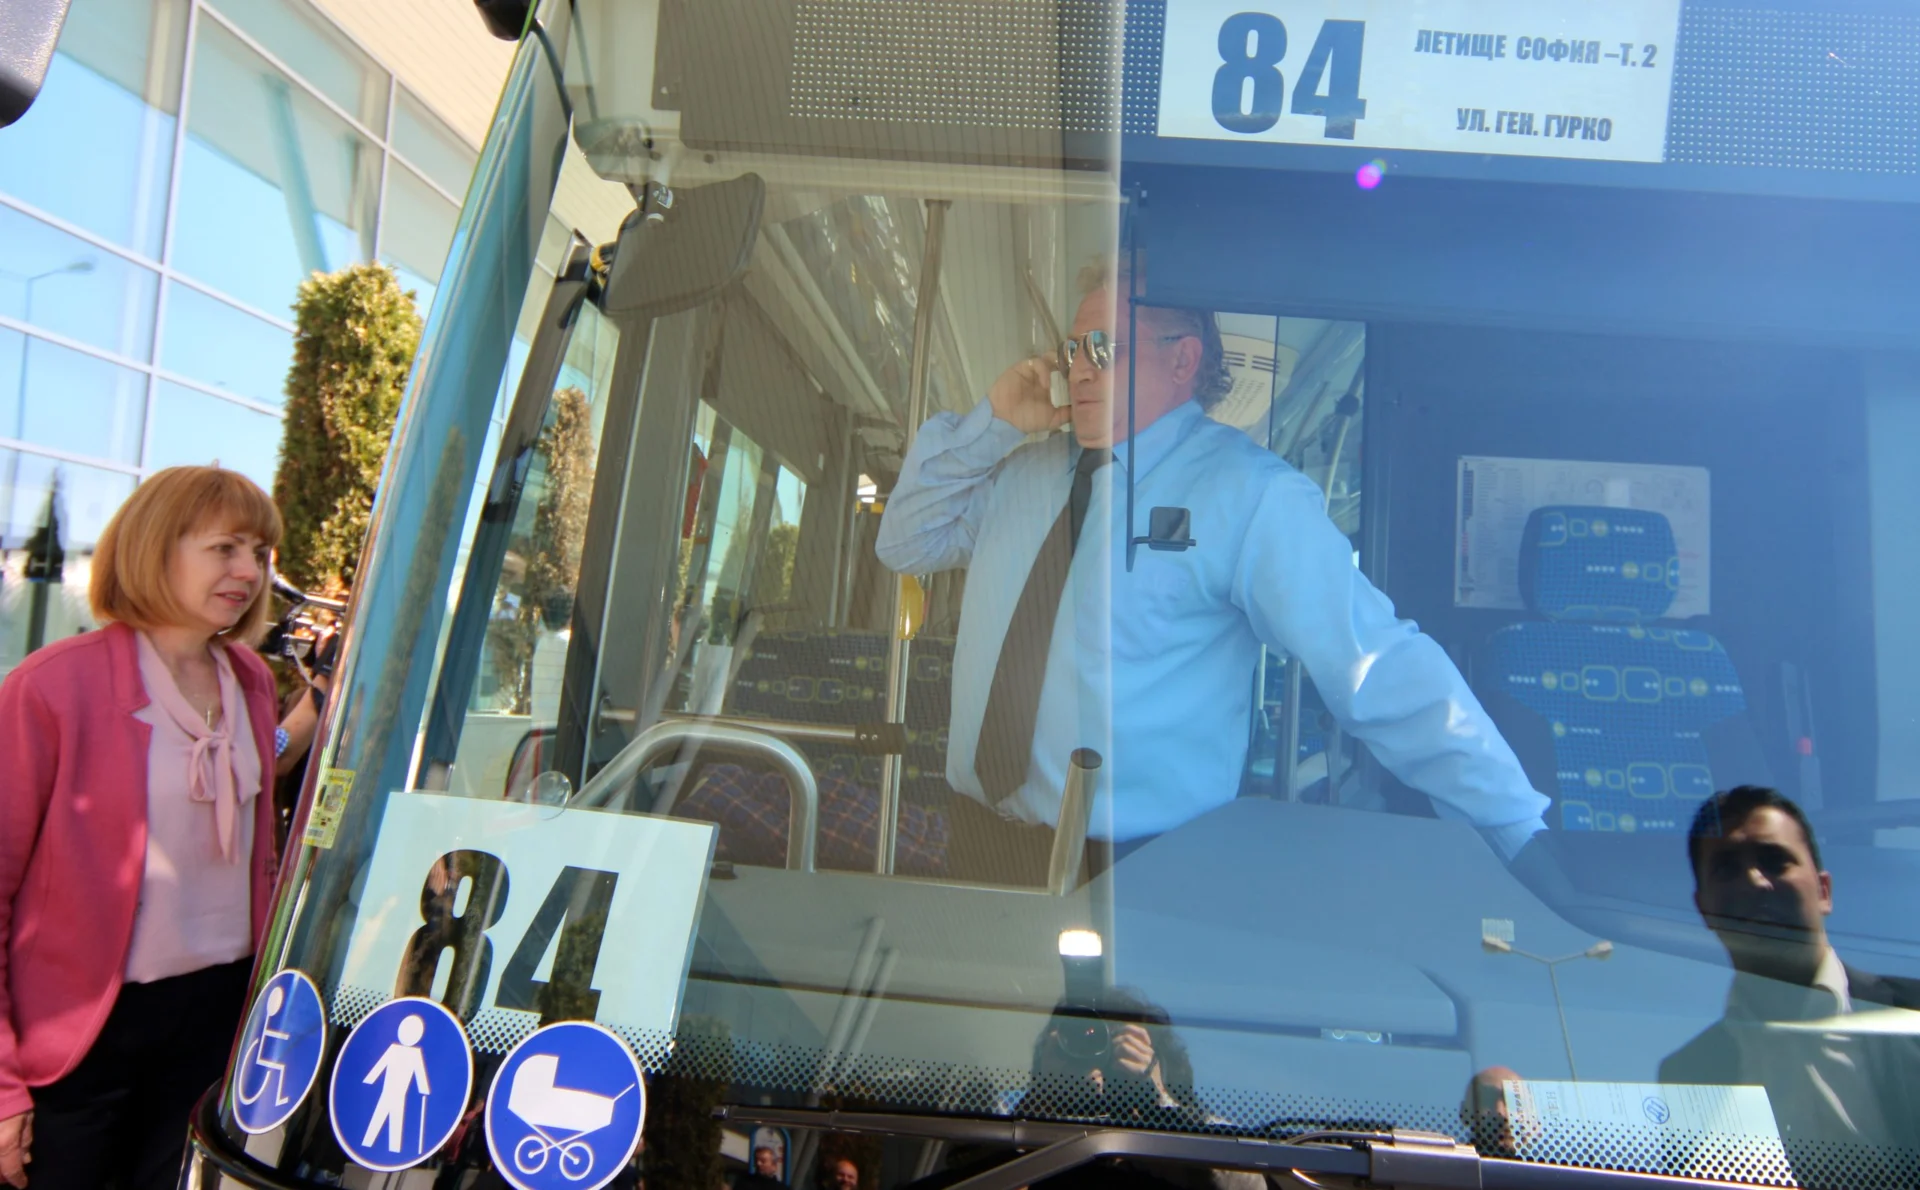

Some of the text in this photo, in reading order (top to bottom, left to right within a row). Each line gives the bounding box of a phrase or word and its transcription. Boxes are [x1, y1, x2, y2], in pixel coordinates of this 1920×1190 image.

[1211, 11, 1367, 140] 84
[1414, 29, 1507, 61] ЛЕТИЩЕ
[1516, 36, 1601, 64] СОФИЯ
[1641, 44, 1658, 68] 2
[1456, 108, 1613, 142] УЛ. ГЕН. ГУРКО
[394, 849, 619, 1027] 84
